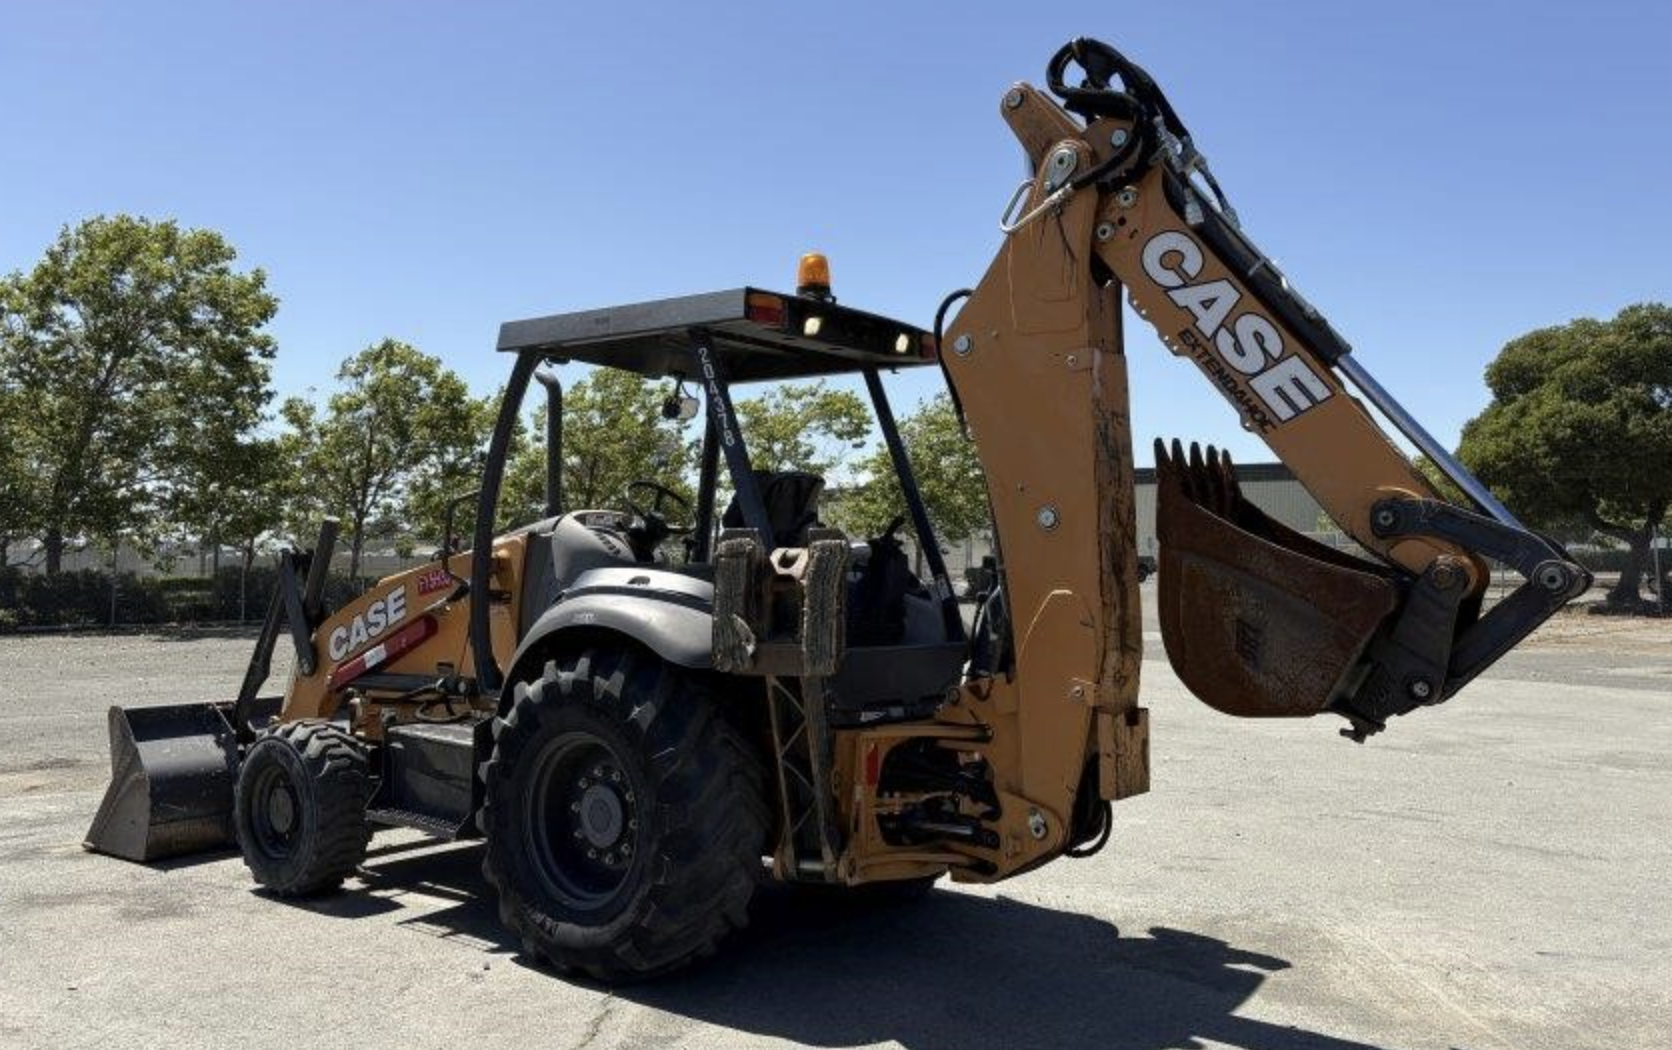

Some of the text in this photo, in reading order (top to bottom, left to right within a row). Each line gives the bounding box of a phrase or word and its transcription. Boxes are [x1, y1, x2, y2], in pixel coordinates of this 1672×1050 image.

[1140, 230, 1335, 423] CASE
[698, 347, 735, 446] 204378
[328, 585, 407, 661] CASE
